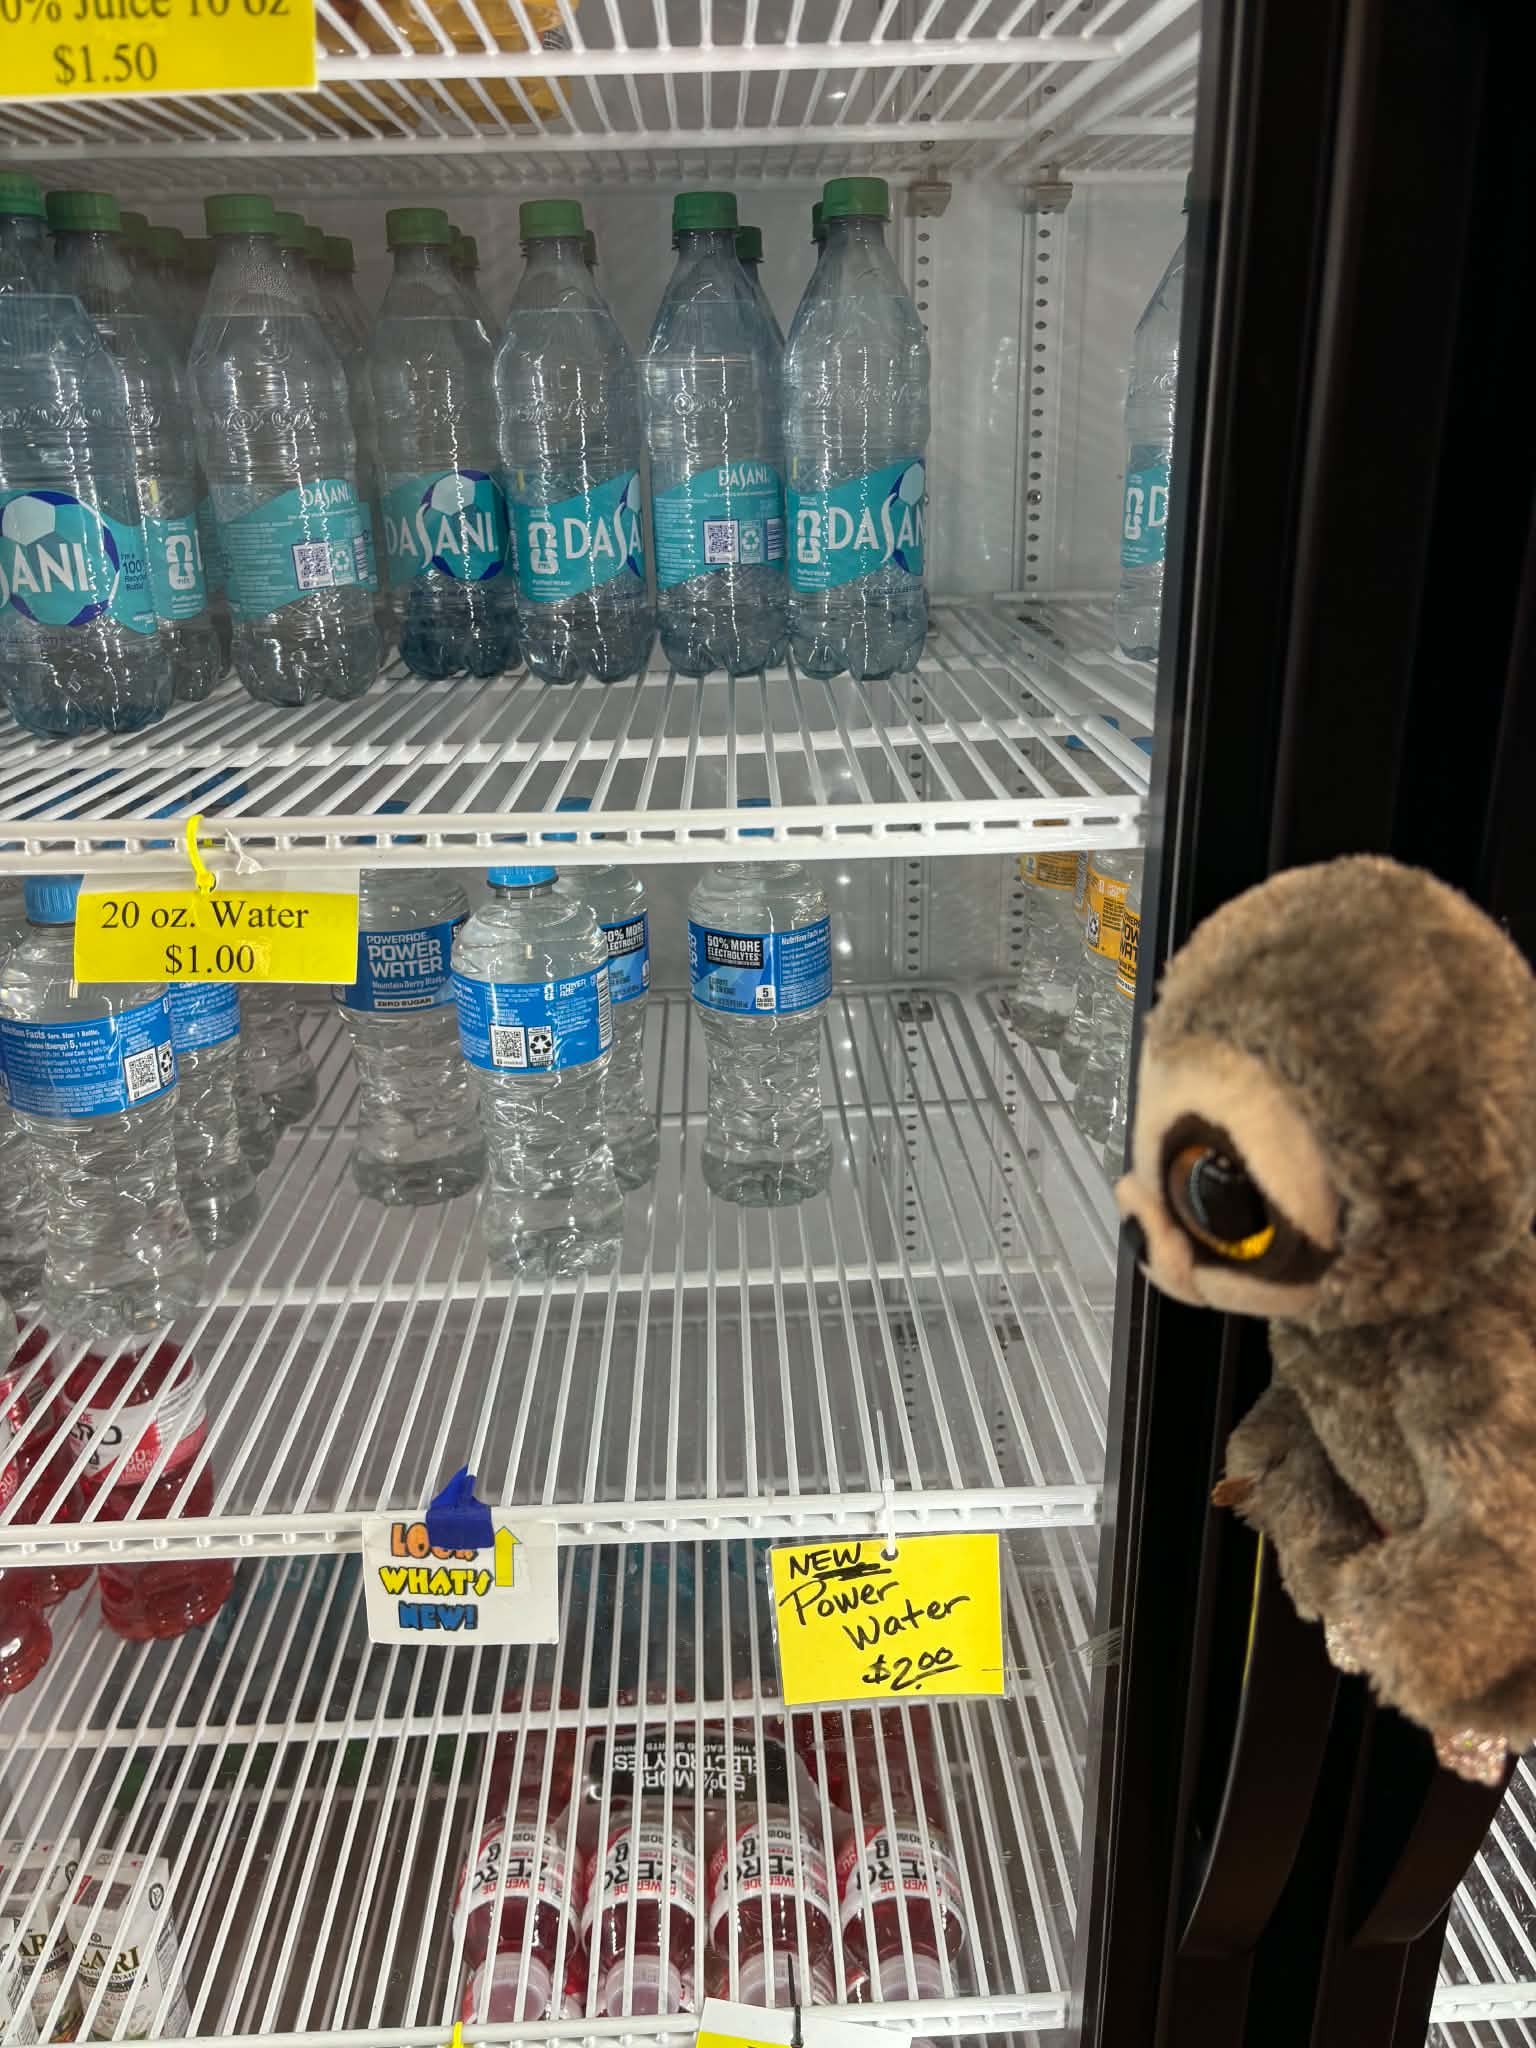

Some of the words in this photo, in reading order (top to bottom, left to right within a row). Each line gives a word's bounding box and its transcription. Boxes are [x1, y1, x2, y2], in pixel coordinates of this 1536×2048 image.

[74, 0, 171, 20] Juice
[53, 42, 158, 86] $1.50
[718, 464, 768, 490] DASANI
[302, 482, 352, 509] DASANI
[384, 502, 498, 569] DASANI
[563, 504, 641, 571] DASA
[0, 543, 90, 608] ANI
[100, 901, 140, 928] 20
[151, 908, 196, 928] oz.
[210, 900, 310, 928] Water
[366, 931, 427, 944] POWERADE
[603, 929, 624, 942] 0%
[708, 936, 729, 950] 50%
[730, 938, 761, 953] MORE
[165, 943, 256, 975] $1.00
[367, 939, 442, 961] POWER
[707, 947, 760, 962] ELECTROLYTES
[369, 955, 443, 978] WATER
[763, 988, 769, 998] 5
[125, 1460, 154, 1473] MOR
[391, 1522, 480, 1561] LO
[789, 1542, 862, 1579] NEW
[379, 1566, 494, 1597] WHAT'S
[778, 1580, 900, 1626] Power
[398, 1601, 479, 1631] NEW!
[842, 1595, 970, 1651] Water
[614, 1752, 761, 1775] LECTOYTES
[633, 1771, 694, 1789] MR
[482, 1880, 545, 1895] PWERDE
[615, 1880, 677, 1896] PWERDE
[744, 1875, 806, 1890] WERDE
[881, 1880, 943, 1896] PWERDE
